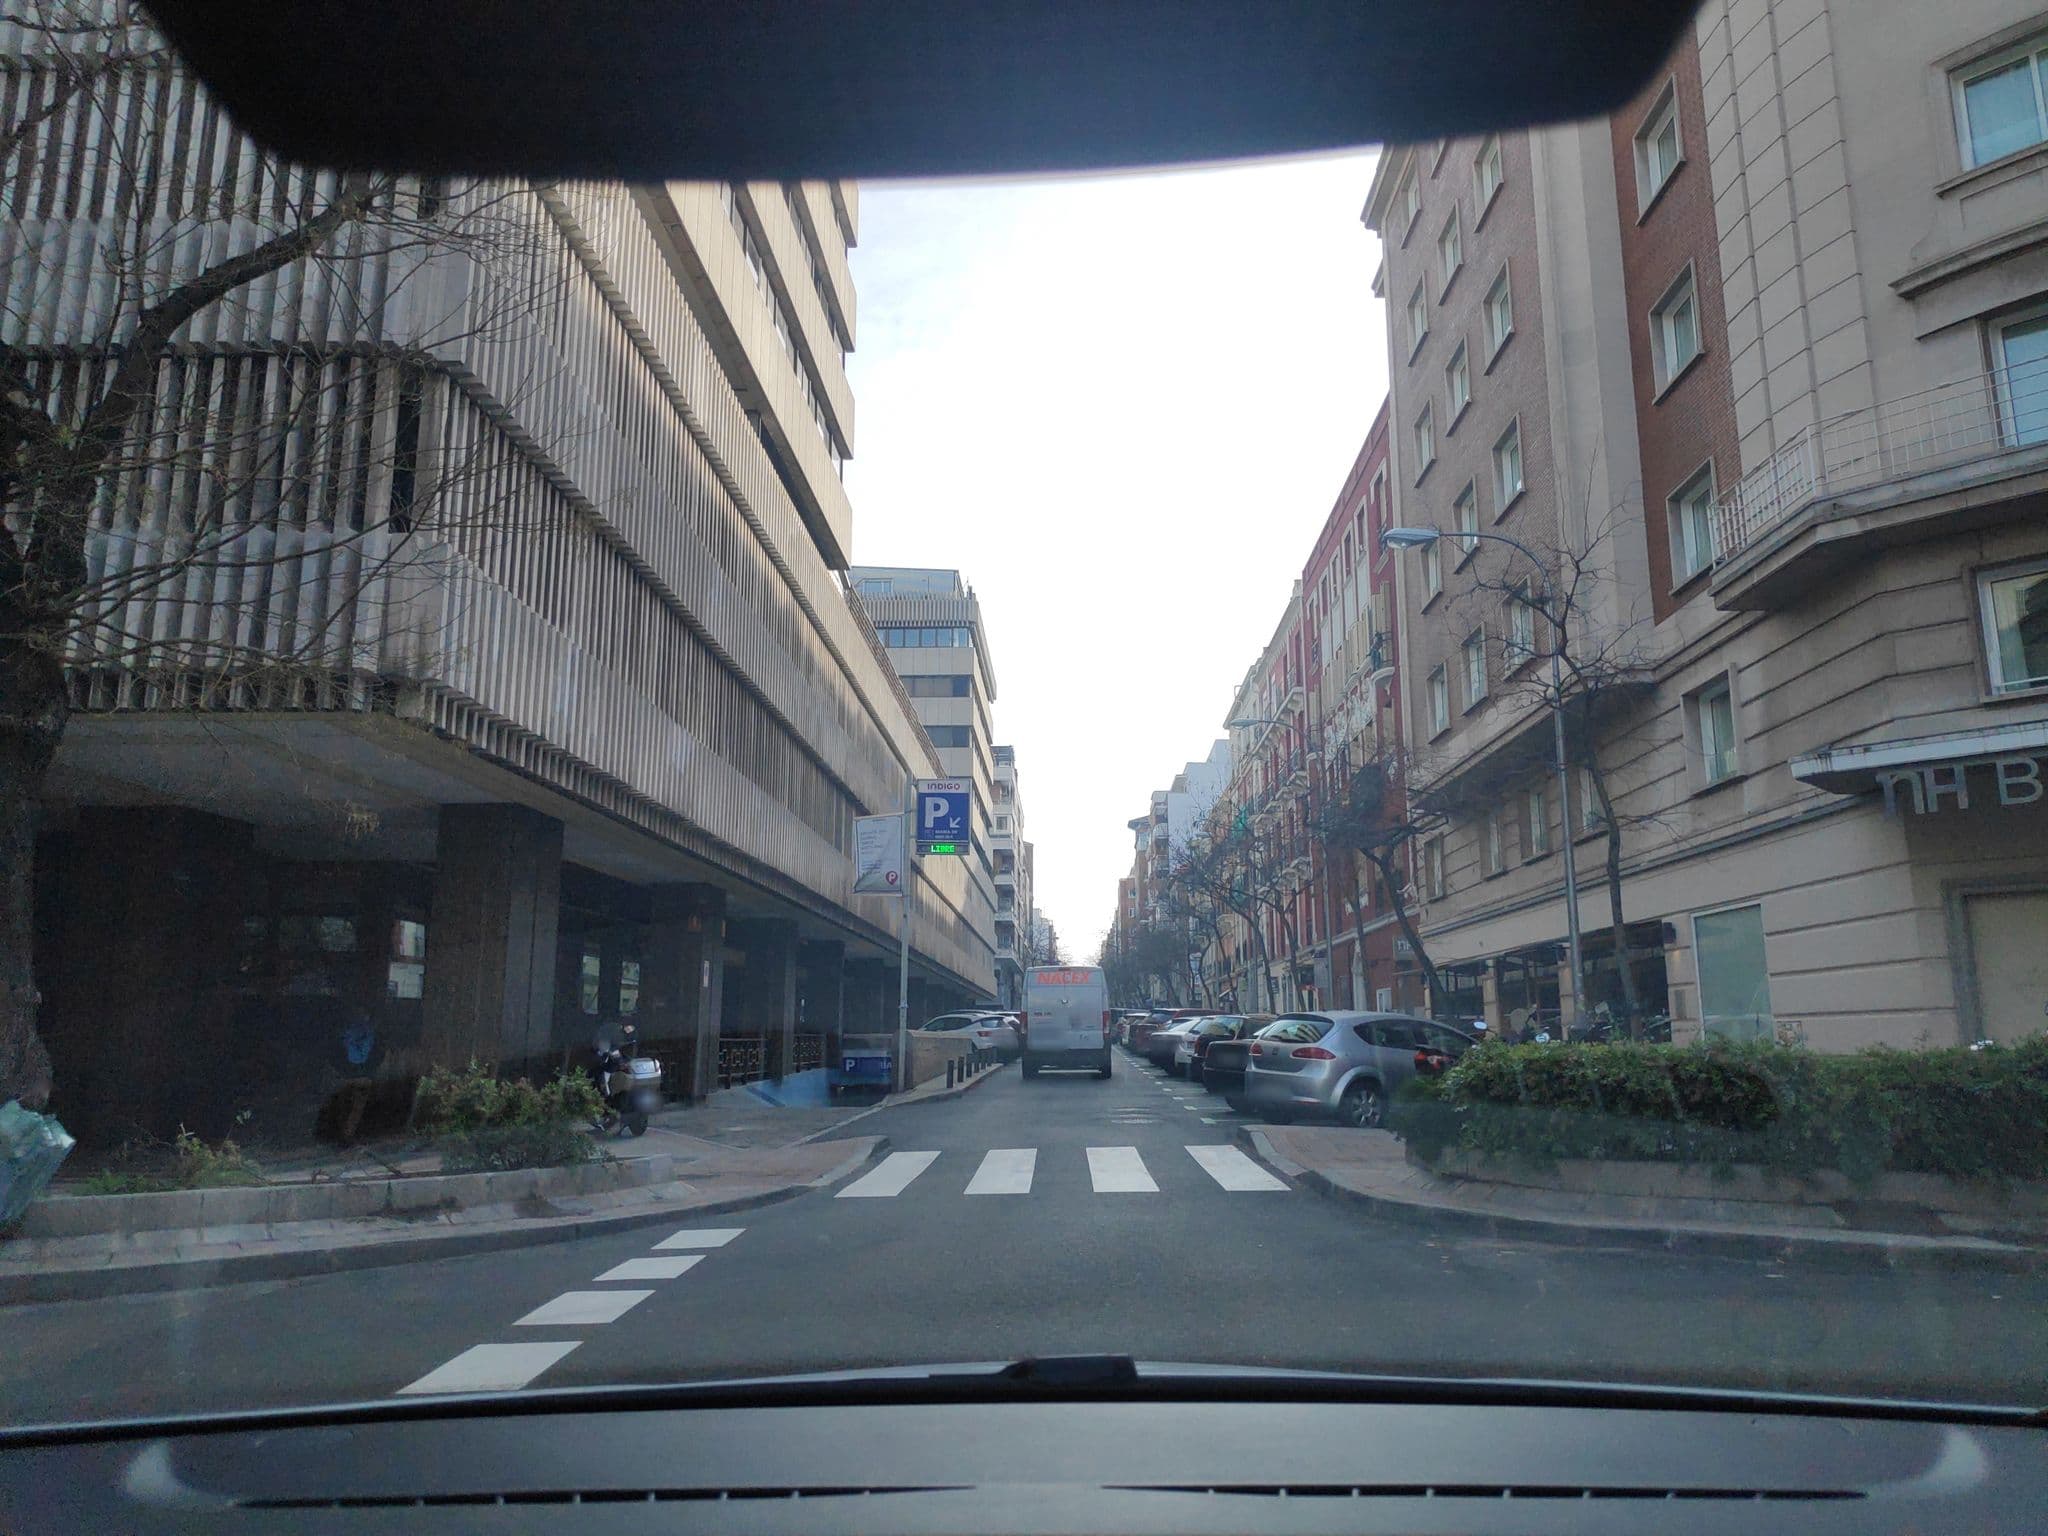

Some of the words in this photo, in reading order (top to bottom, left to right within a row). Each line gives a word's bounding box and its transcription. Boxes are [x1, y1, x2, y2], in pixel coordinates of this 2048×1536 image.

[927, 782, 961, 791] INDIGO
[924, 796, 950, 828] P
[931, 844, 955, 853] LIBRE
[1036, 971, 1089, 984] NACEX
[845, 1058, 856, 1072] P
